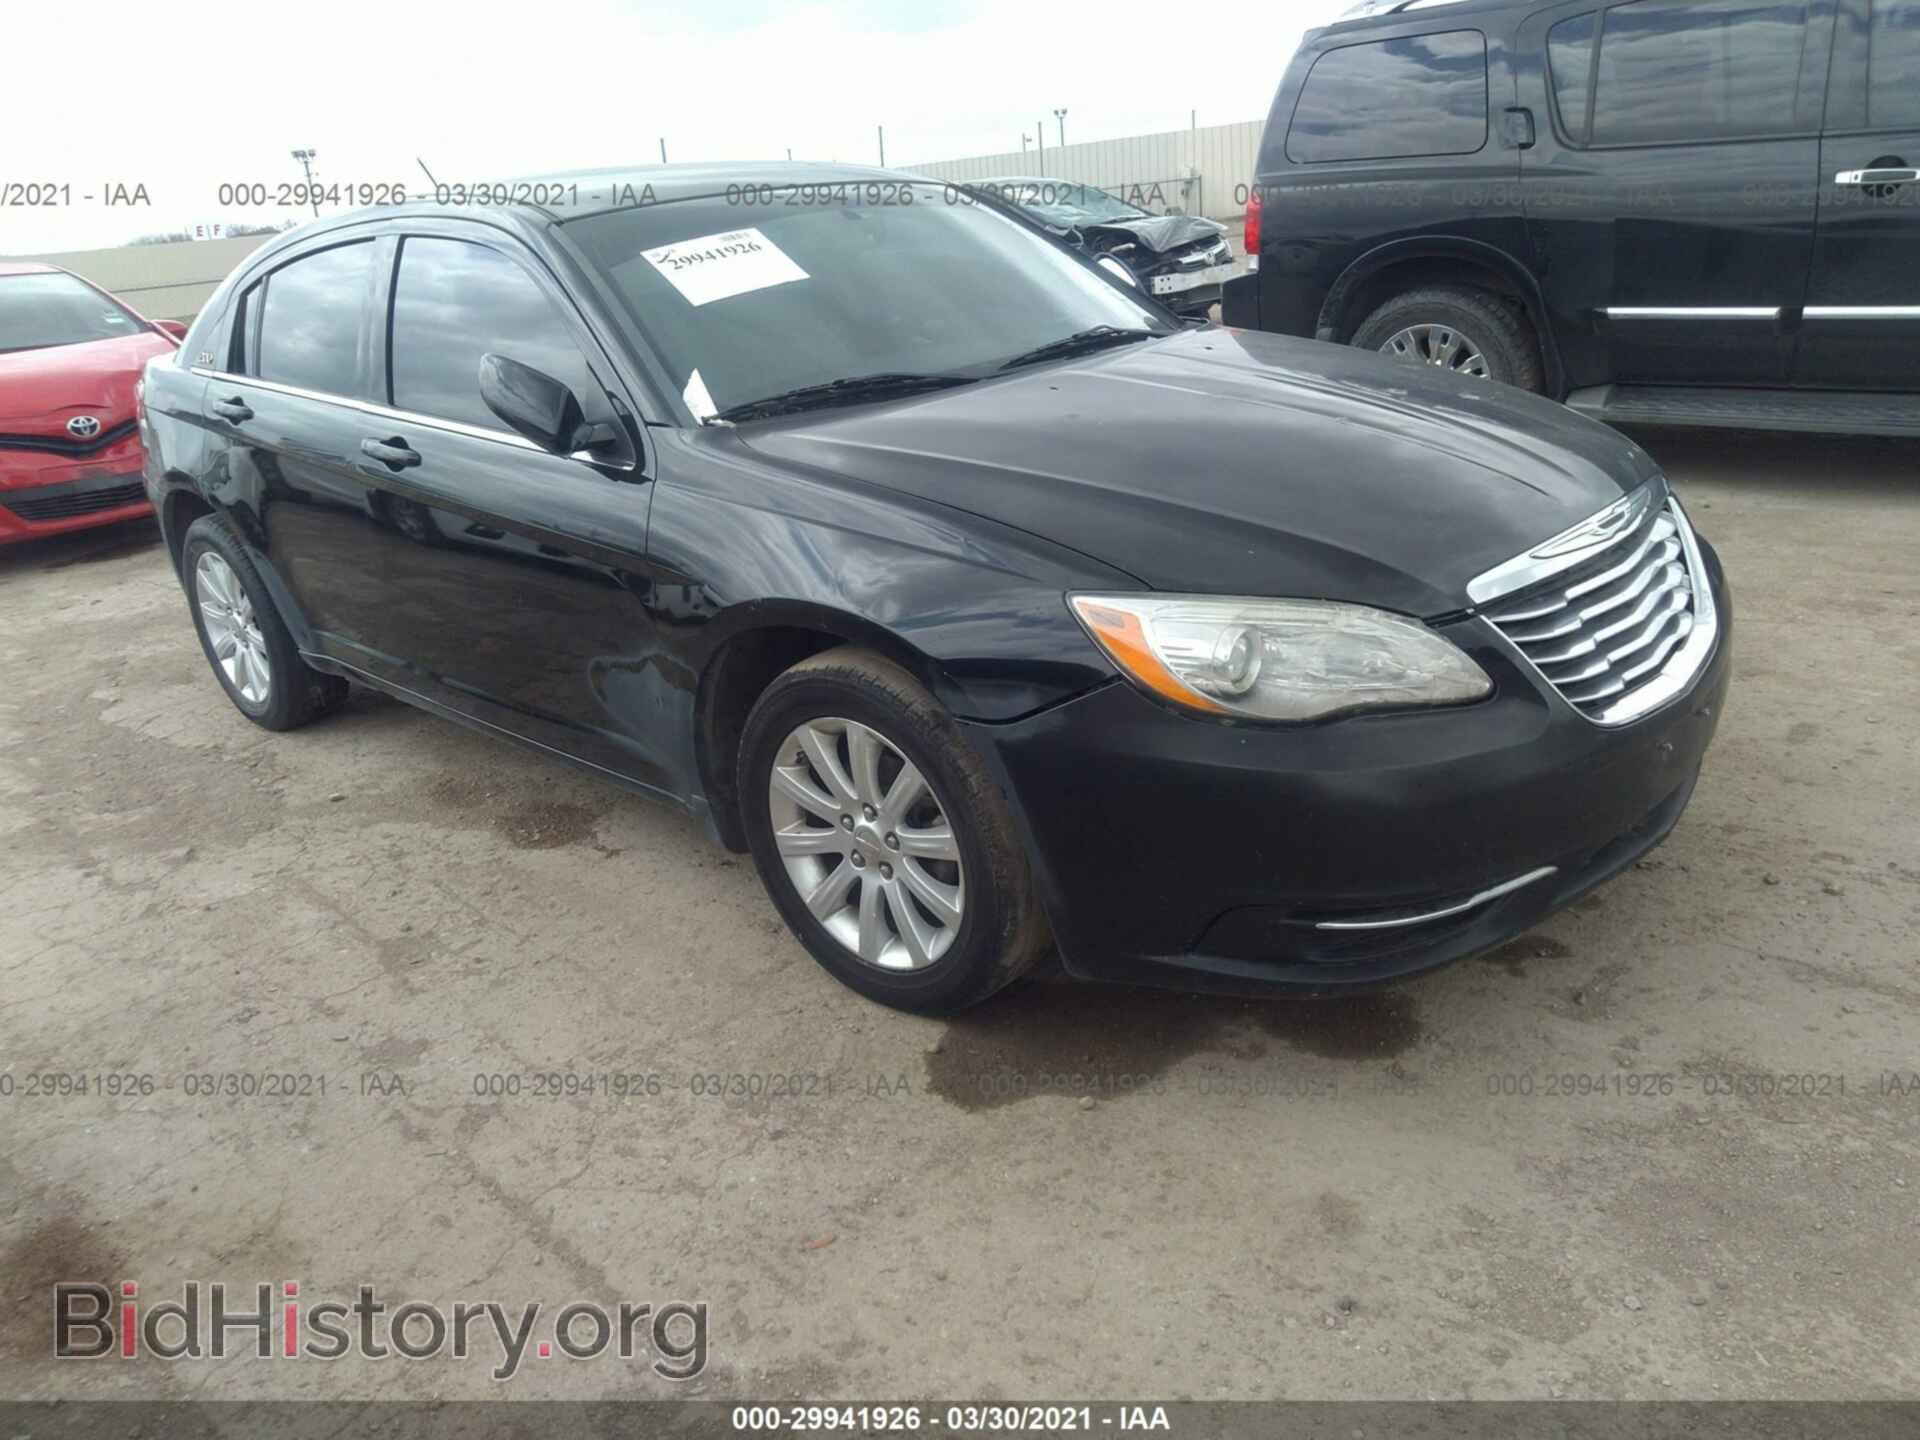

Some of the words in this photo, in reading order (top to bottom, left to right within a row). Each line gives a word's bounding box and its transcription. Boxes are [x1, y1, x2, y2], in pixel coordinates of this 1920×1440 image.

[195, 225, 204, 237] E
[214, 223, 221, 236] F
[667, 241, 762, 270] 29941926
